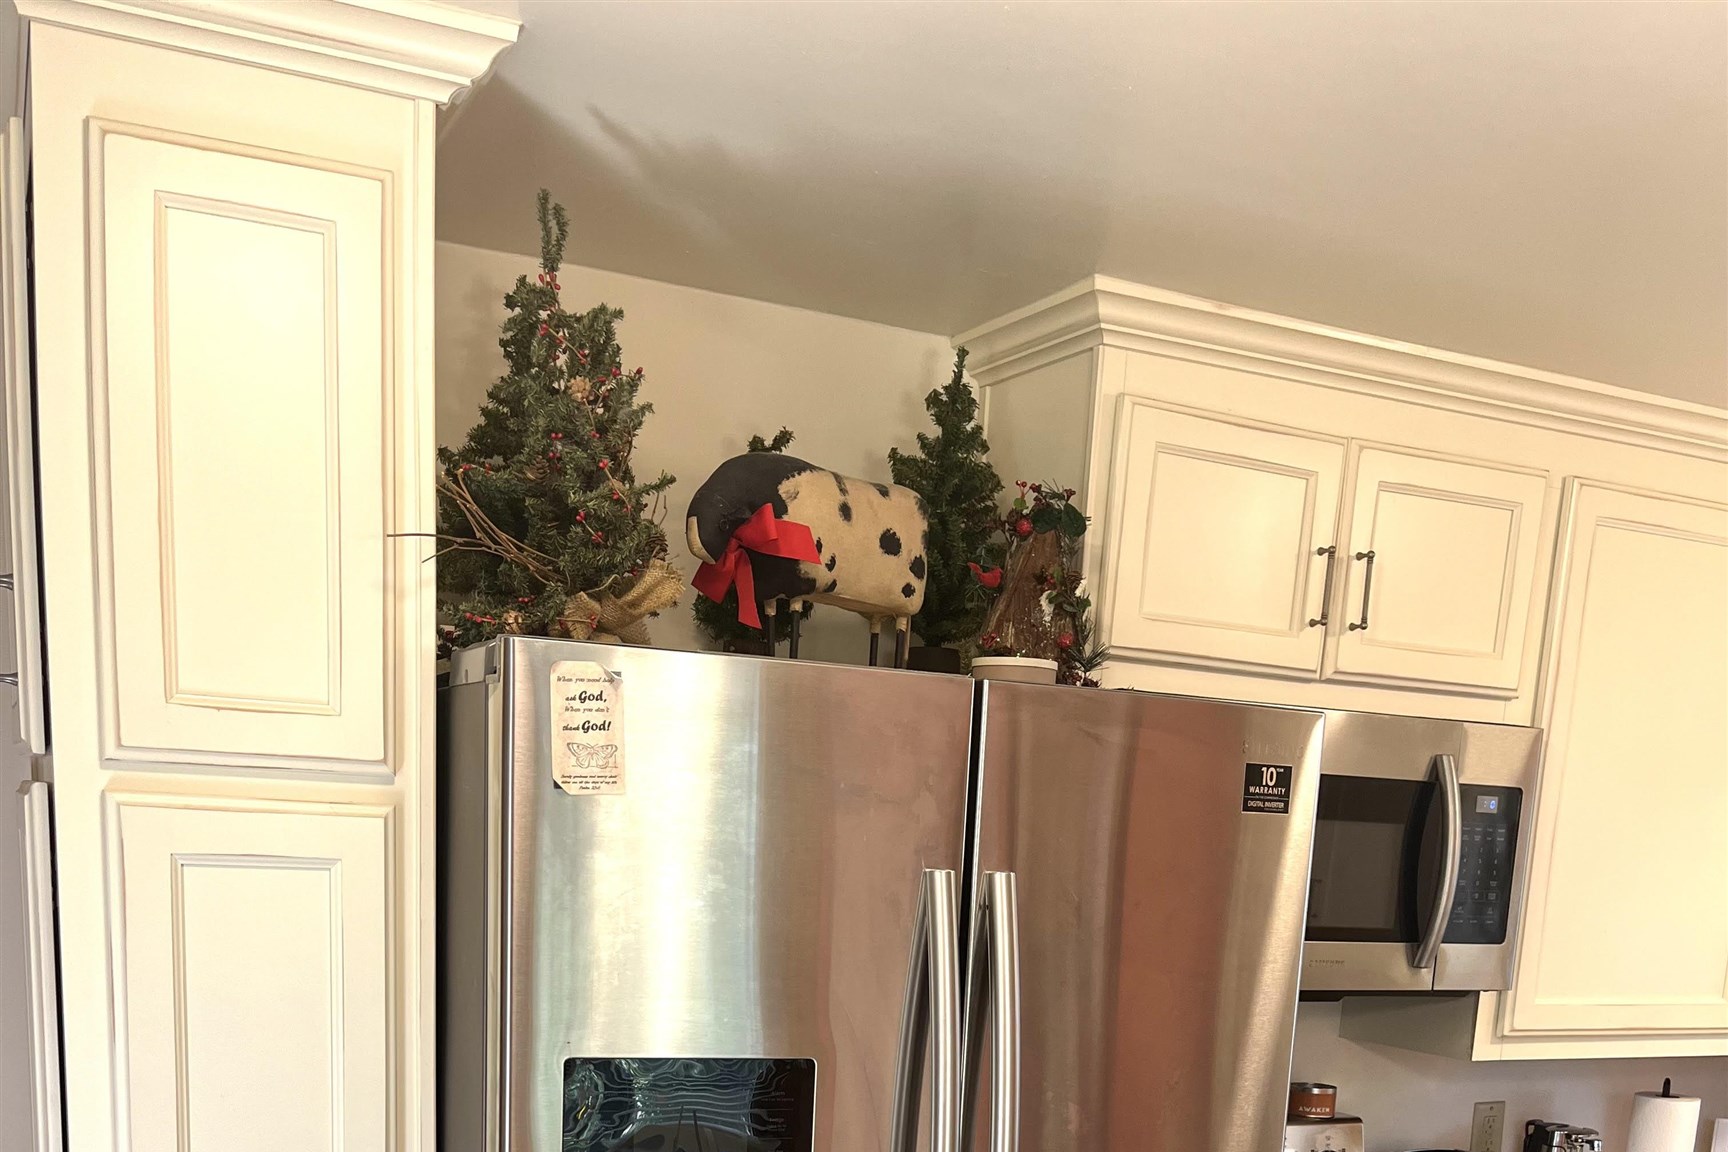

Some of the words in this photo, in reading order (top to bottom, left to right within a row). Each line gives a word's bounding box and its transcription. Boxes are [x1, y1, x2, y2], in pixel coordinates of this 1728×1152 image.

[565, 694, 577, 702] ask
[578, 690, 607, 704] God,
[562, 724, 580, 732] thank
[581, 720, 612, 734] God!
[1261, 767, 1277, 787] 10
[1249, 786, 1286, 795] WARRANTY
[1247, 800, 1264, 808] DIGITAL
